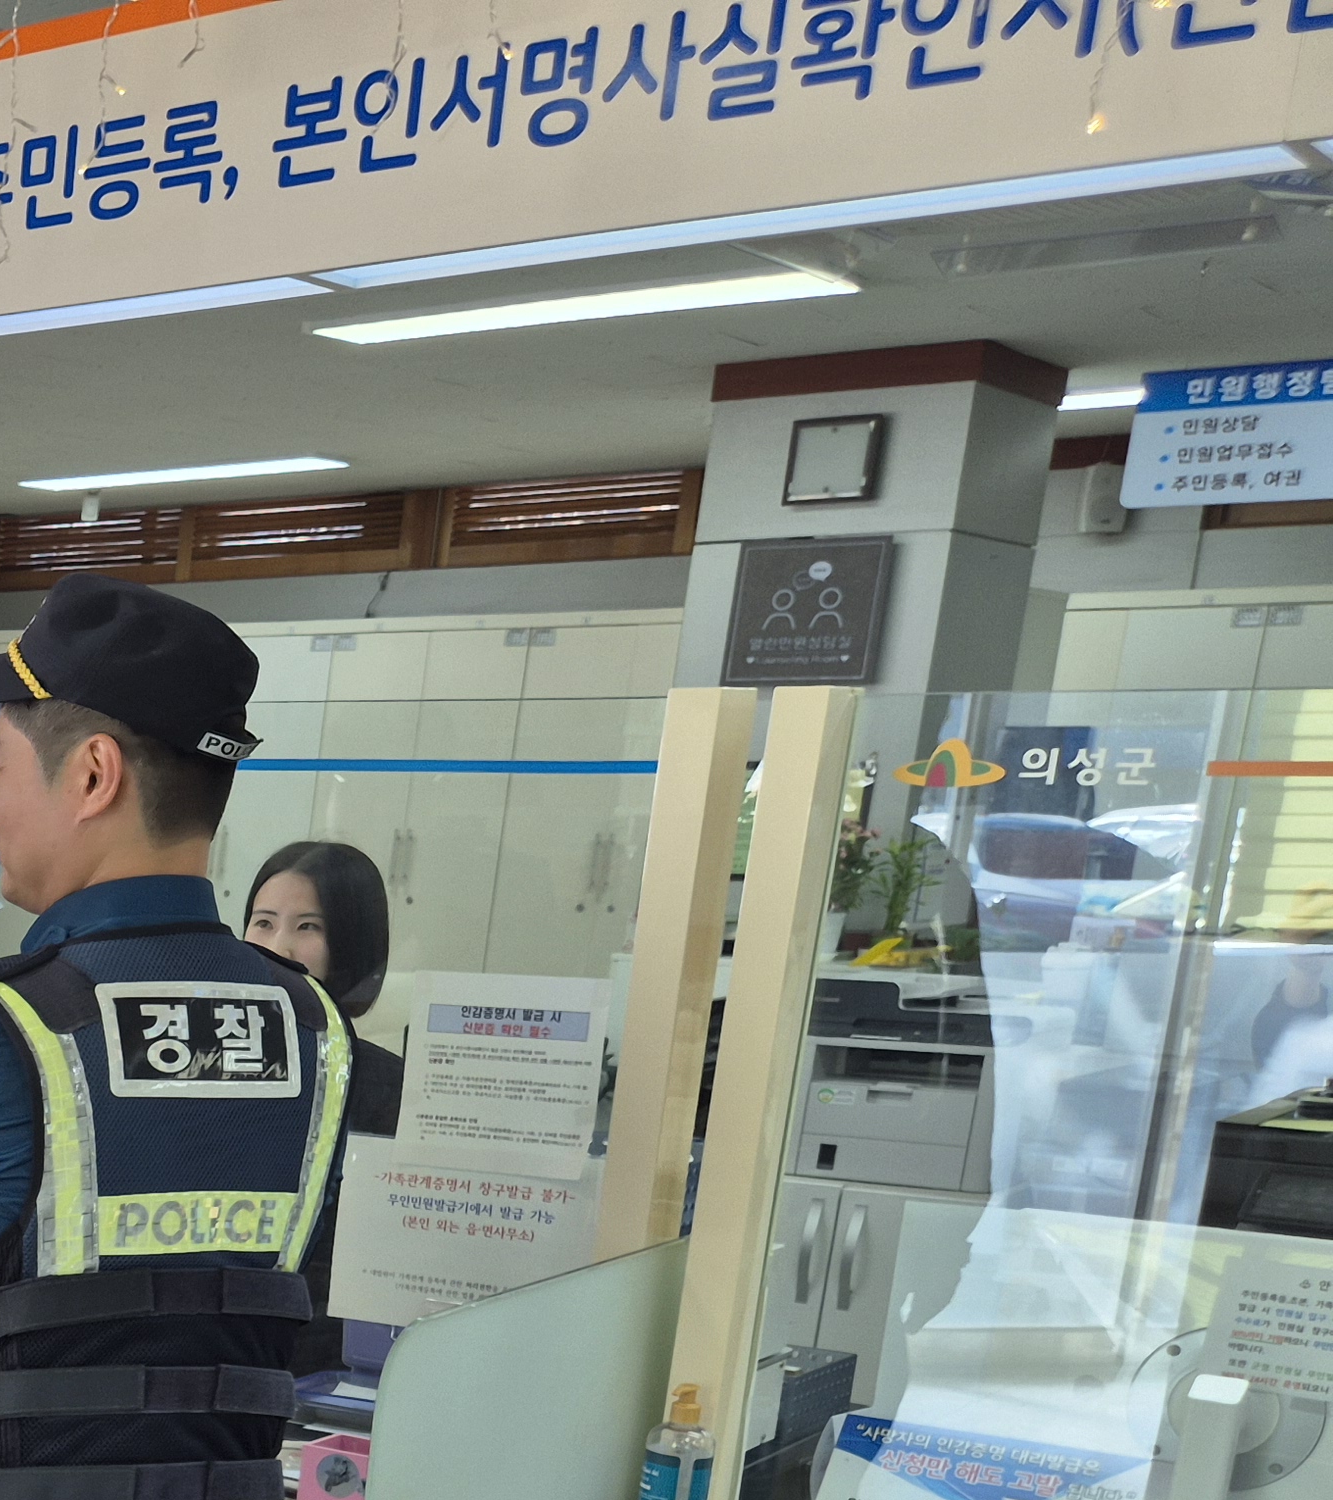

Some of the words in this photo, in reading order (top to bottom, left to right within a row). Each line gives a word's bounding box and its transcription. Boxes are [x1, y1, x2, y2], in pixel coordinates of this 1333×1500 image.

[1182, 414, 1259, 436] 민원상담
[1176, 441, 1293, 464] 민원업무접수
[1171, 471, 1254, 492] 주민등록,
[1263, 469, 1302, 487] 여권
[1018, 747, 1156, 786] 의성군
[460, 1005, 516, 1020] 인감증명서
[550, 1011, 562, 1023] 시
[139, 1003, 264, 1073] 경찰
[479, 1181, 533, 1201] 창구발급
[115, 1200, 276, 1248] POLICE
[387, 1193, 493, 1217] 무인민원발급기에서
[500, 1205, 524, 1221] 발급
[530, 1210, 556, 1225] 가능
[937, 1436, 1006, 1462] 인감증명
[1010, 1448, 1101, 1476] 대리발급은
[879, 1449, 951, 1480] 신청만
[955, 1461, 1005, 1487] 해도
[1007, 1471, 1064, 1498] 고발
